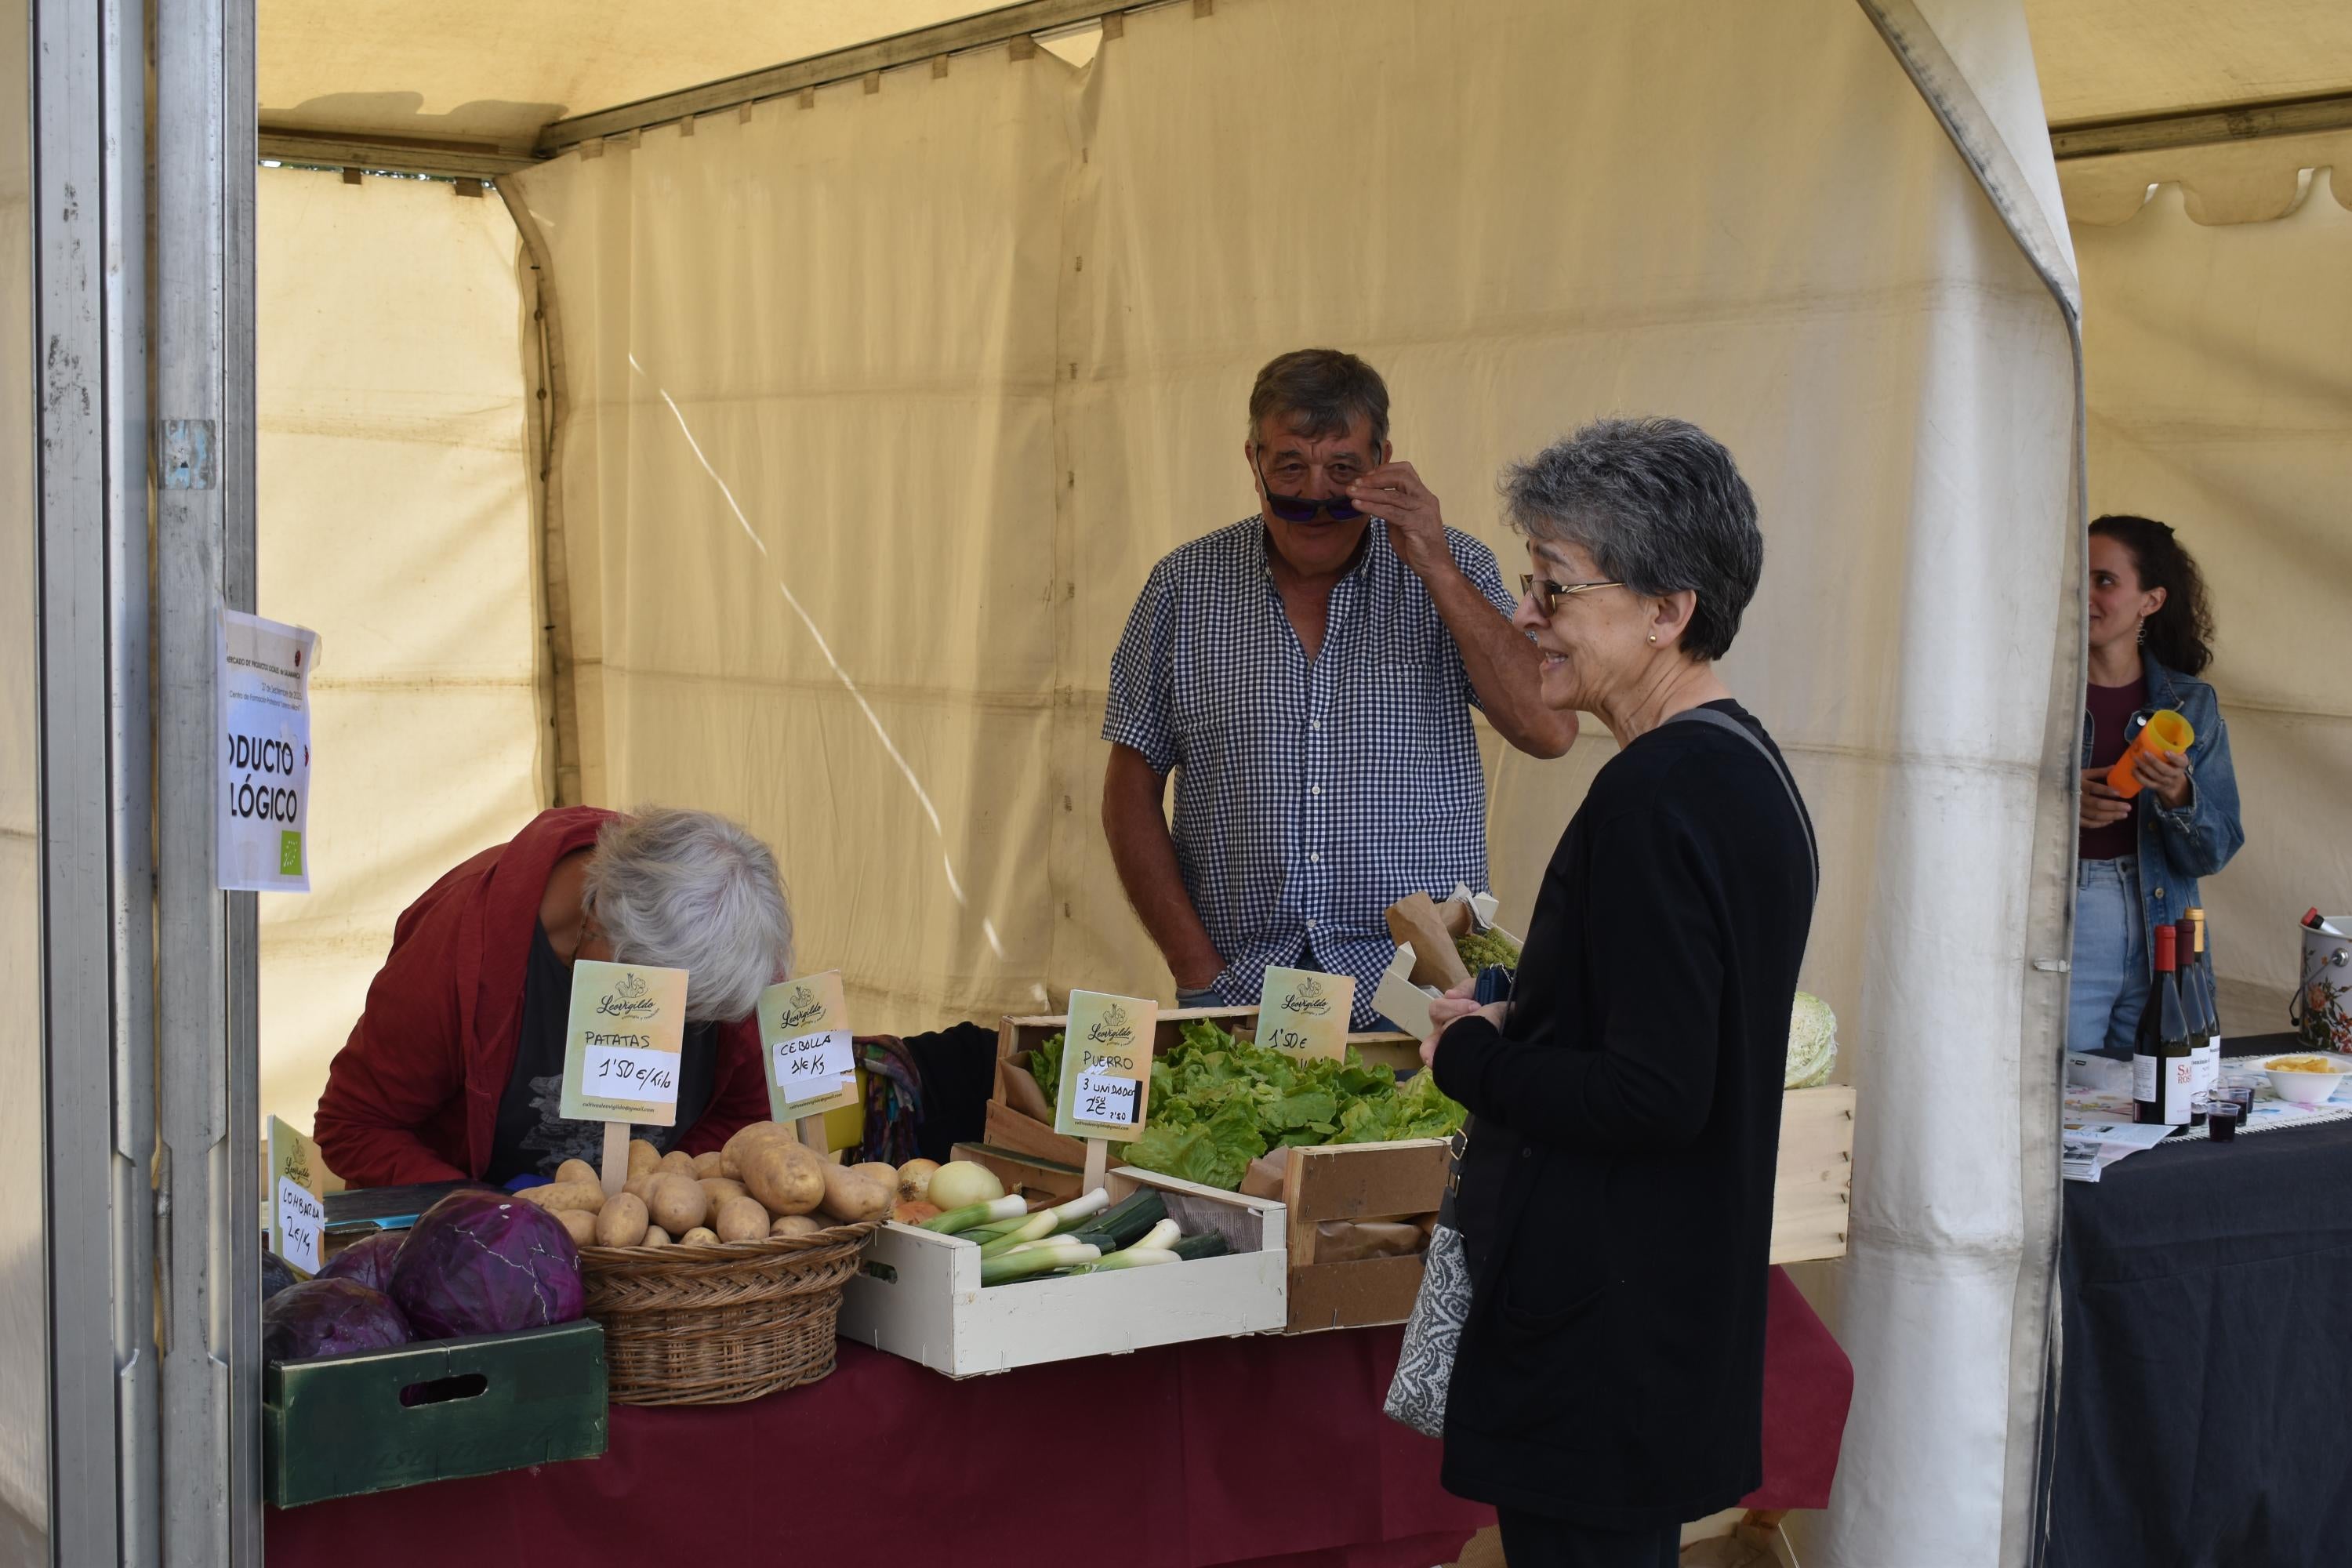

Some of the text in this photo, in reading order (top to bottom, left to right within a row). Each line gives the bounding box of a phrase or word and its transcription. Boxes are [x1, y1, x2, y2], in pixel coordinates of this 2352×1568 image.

[595, 995, 655, 1017] Leovigildo
[1281, 994, 1328, 1012] Leovigildo
[585, 1031, 650, 1049] PATATAS
[1087, 1022, 1133, 1042] Leovigildo
[780, 1033, 831, 1056] CEBOLLA
[1083, 1051, 1134, 1069] PUERRO
[1083, 1077, 1089, 1091] 3
